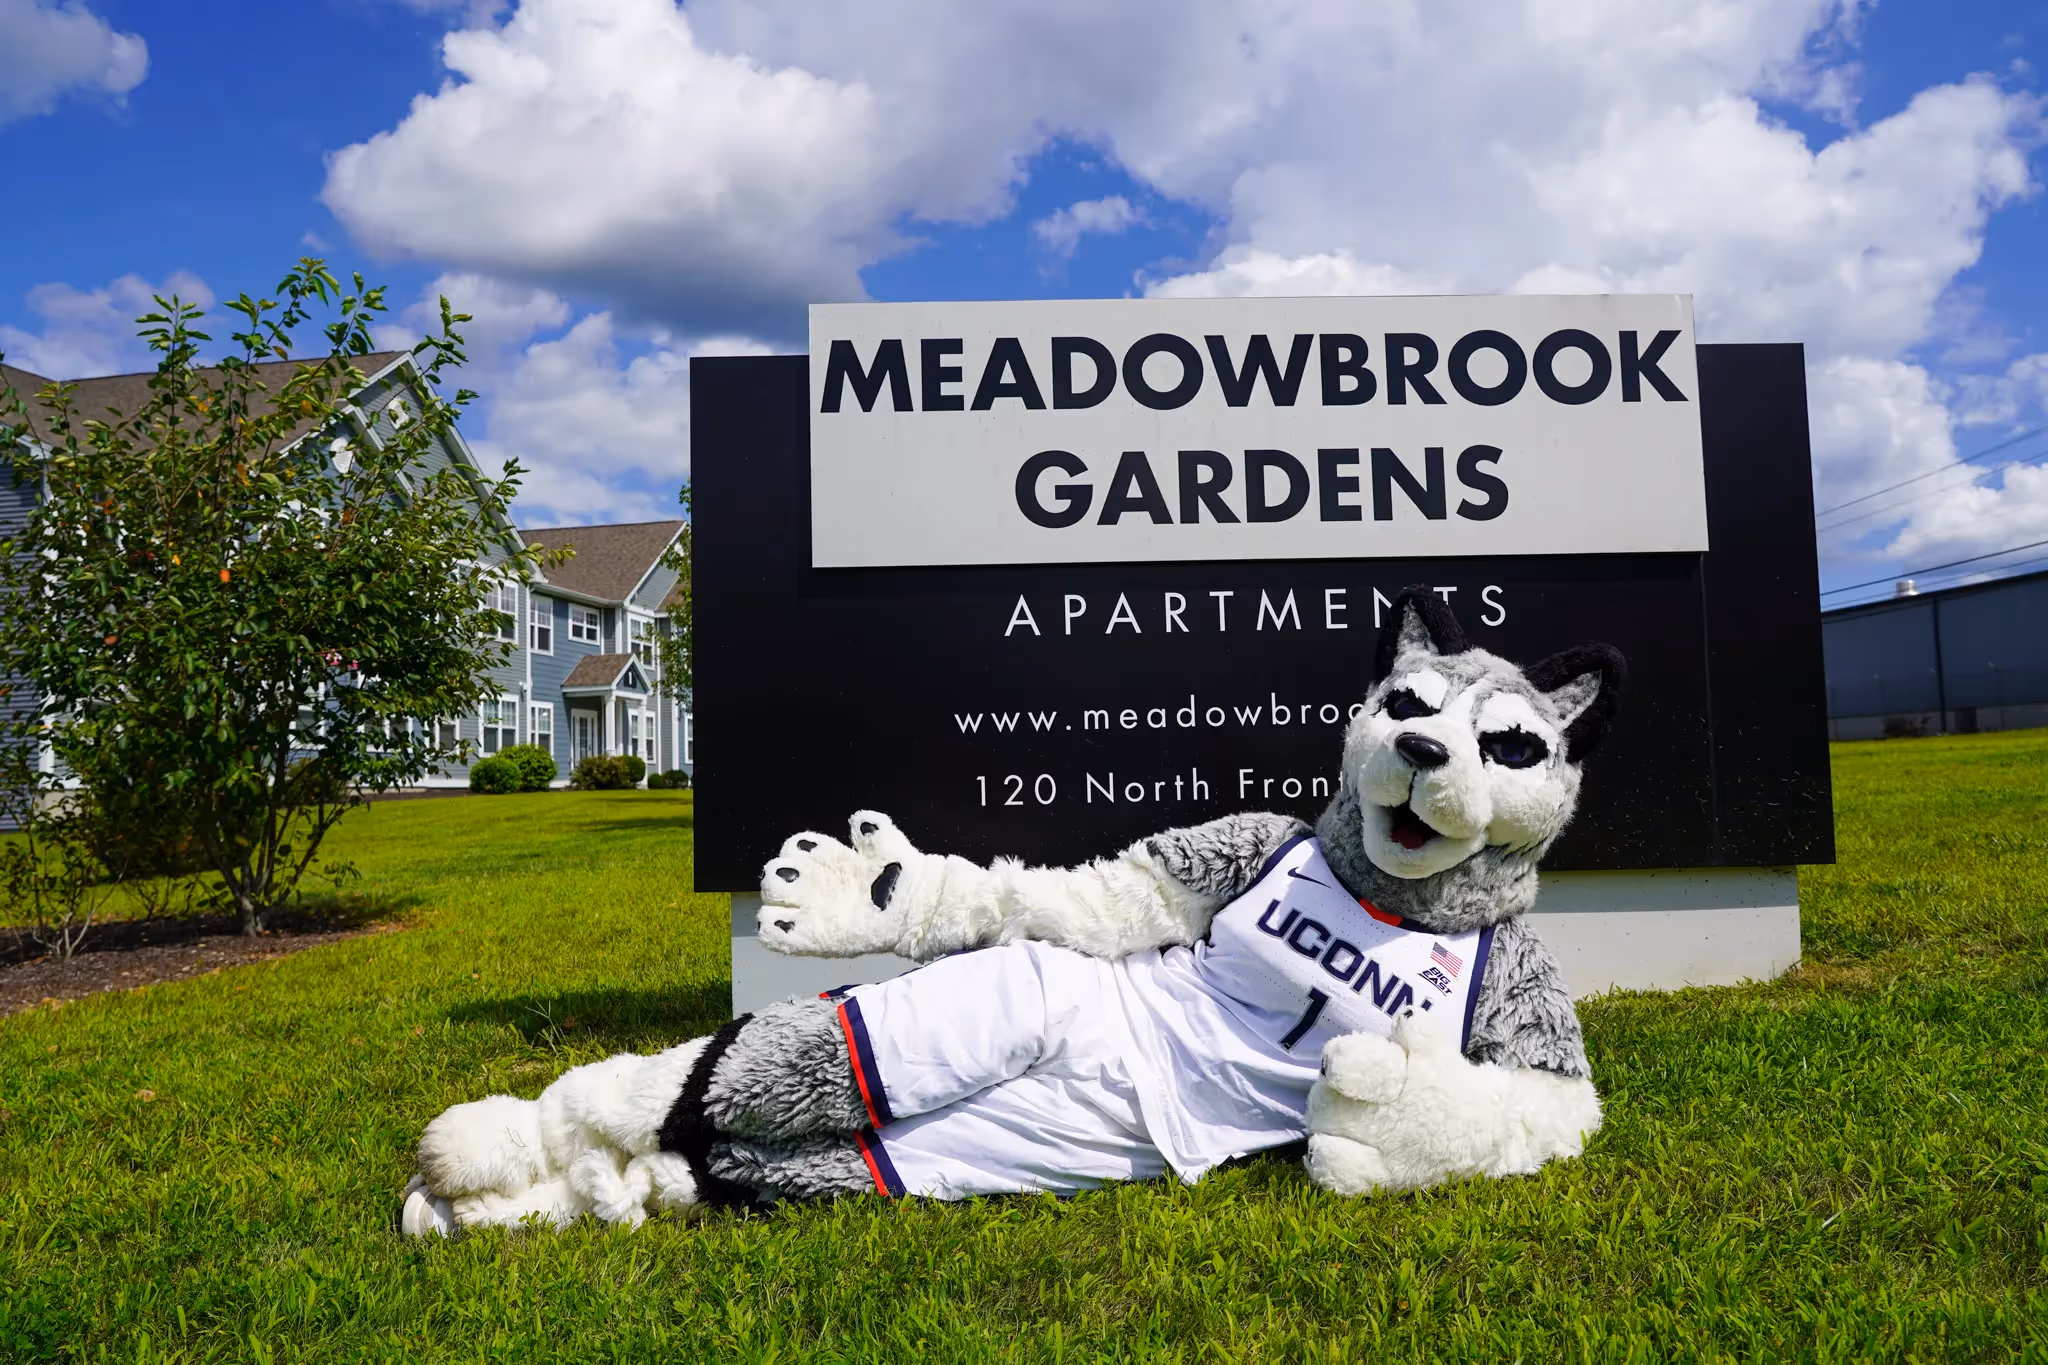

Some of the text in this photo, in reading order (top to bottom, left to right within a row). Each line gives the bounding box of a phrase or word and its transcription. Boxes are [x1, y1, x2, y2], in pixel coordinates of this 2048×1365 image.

[821, 329, 1689, 413] MEADOWBROOK
[1015, 445, 1509, 528] GARDENS
[976, 767, 1343, 807] 120 North Fron
[1422, 970, 1453, 994] EAST
[1429, 967, 1451, 985] BIG
[1278, 985, 1332, 1050] 1
